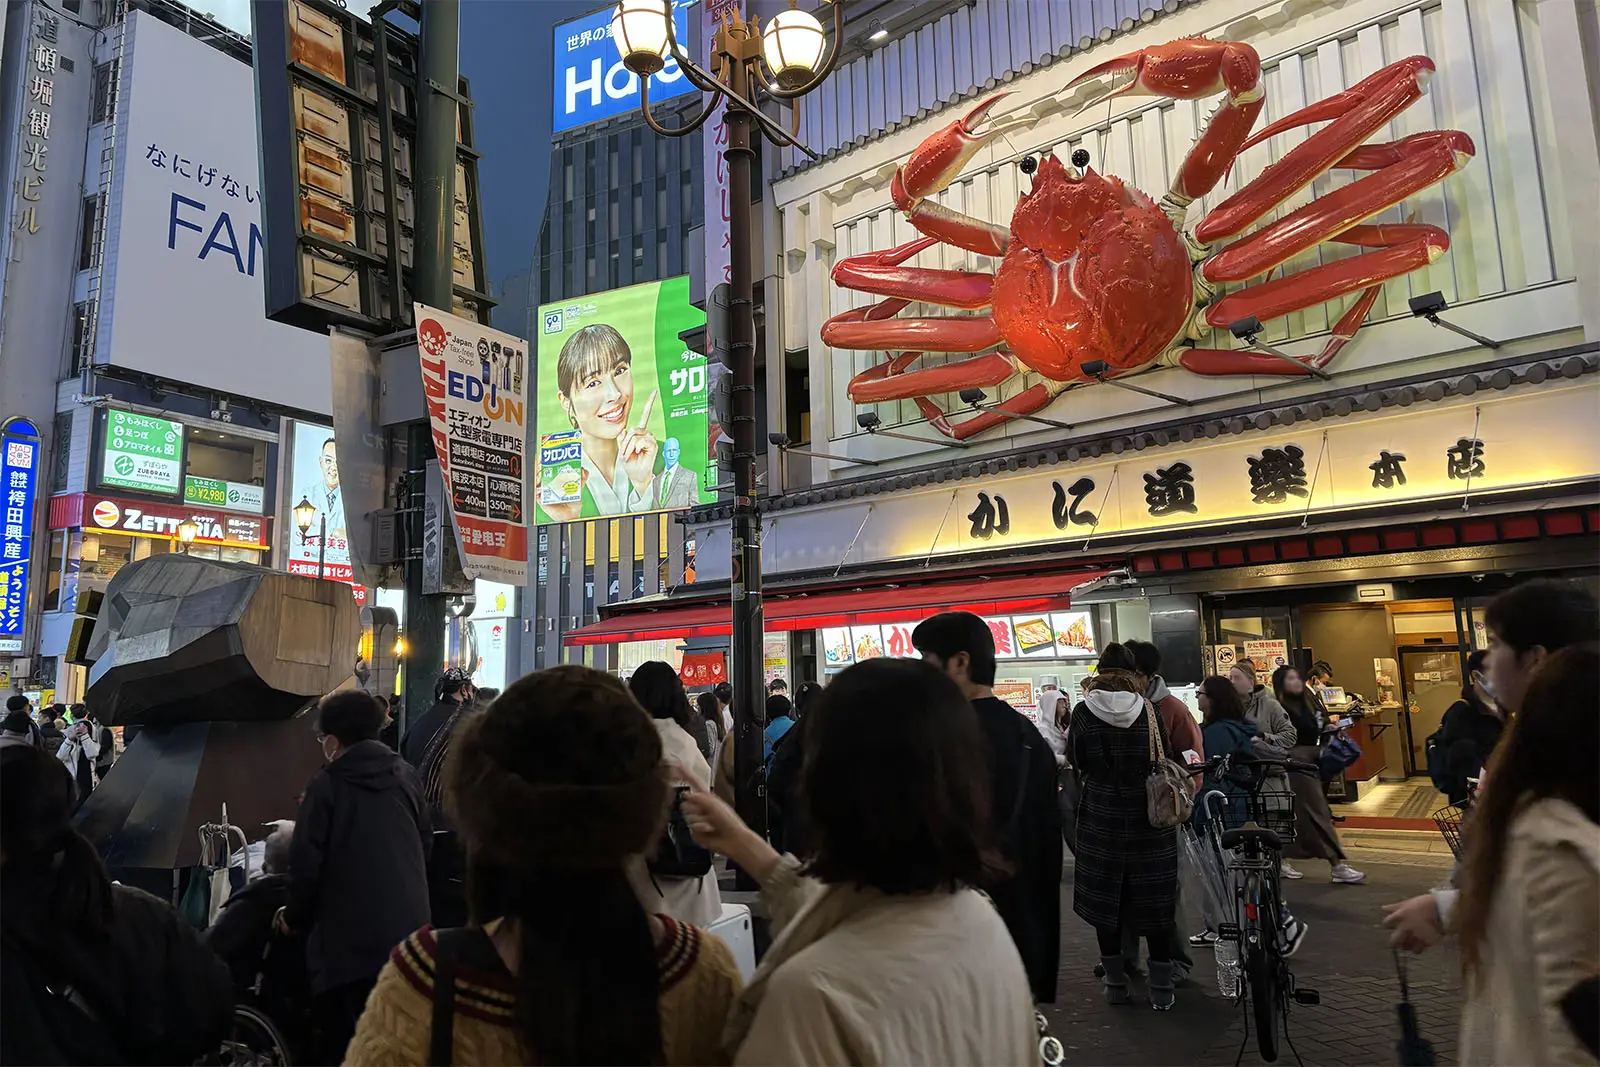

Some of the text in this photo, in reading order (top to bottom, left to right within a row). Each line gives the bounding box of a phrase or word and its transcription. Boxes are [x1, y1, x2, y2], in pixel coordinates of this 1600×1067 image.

[18, 10, 59, 235] 道頓堀観光ビル
[146, 143, 261, 203] なにげない
[450, 343, 475, 359] Tax-free
[458, 355, 475, 368] Shop
[669, 365, 707, 396] サロ
[422, 357, 446, 423] TAX
[448, 370, 523, 427] EDION
[127, 416, 163, 430] もみほぐし
[448, 408, 491, 429] エディオン
[125, 428, 149, 440] 足つぼ
[448, 422, 523, 453] 大型家電専門店
[124, 440, 163, 454] アロマオイル
[452, 442, 509, 466] 道頓堀店 220m
[543, 445, 581, 463] サロンパス
[137, 468, 171, 478] ZUBORAYA
[451, 471, 485, 489] 難波本店
[193, 479, 219, 488] もみほぐし
[490, 479, 521, 496] 心斎橋店
[198, 487, 225, 502] ¥2,980
[465, 495, 486, 508] 400m
[489, 499, 512, 512] 350m
[123, 508, 224, 540] ZETTRIA
